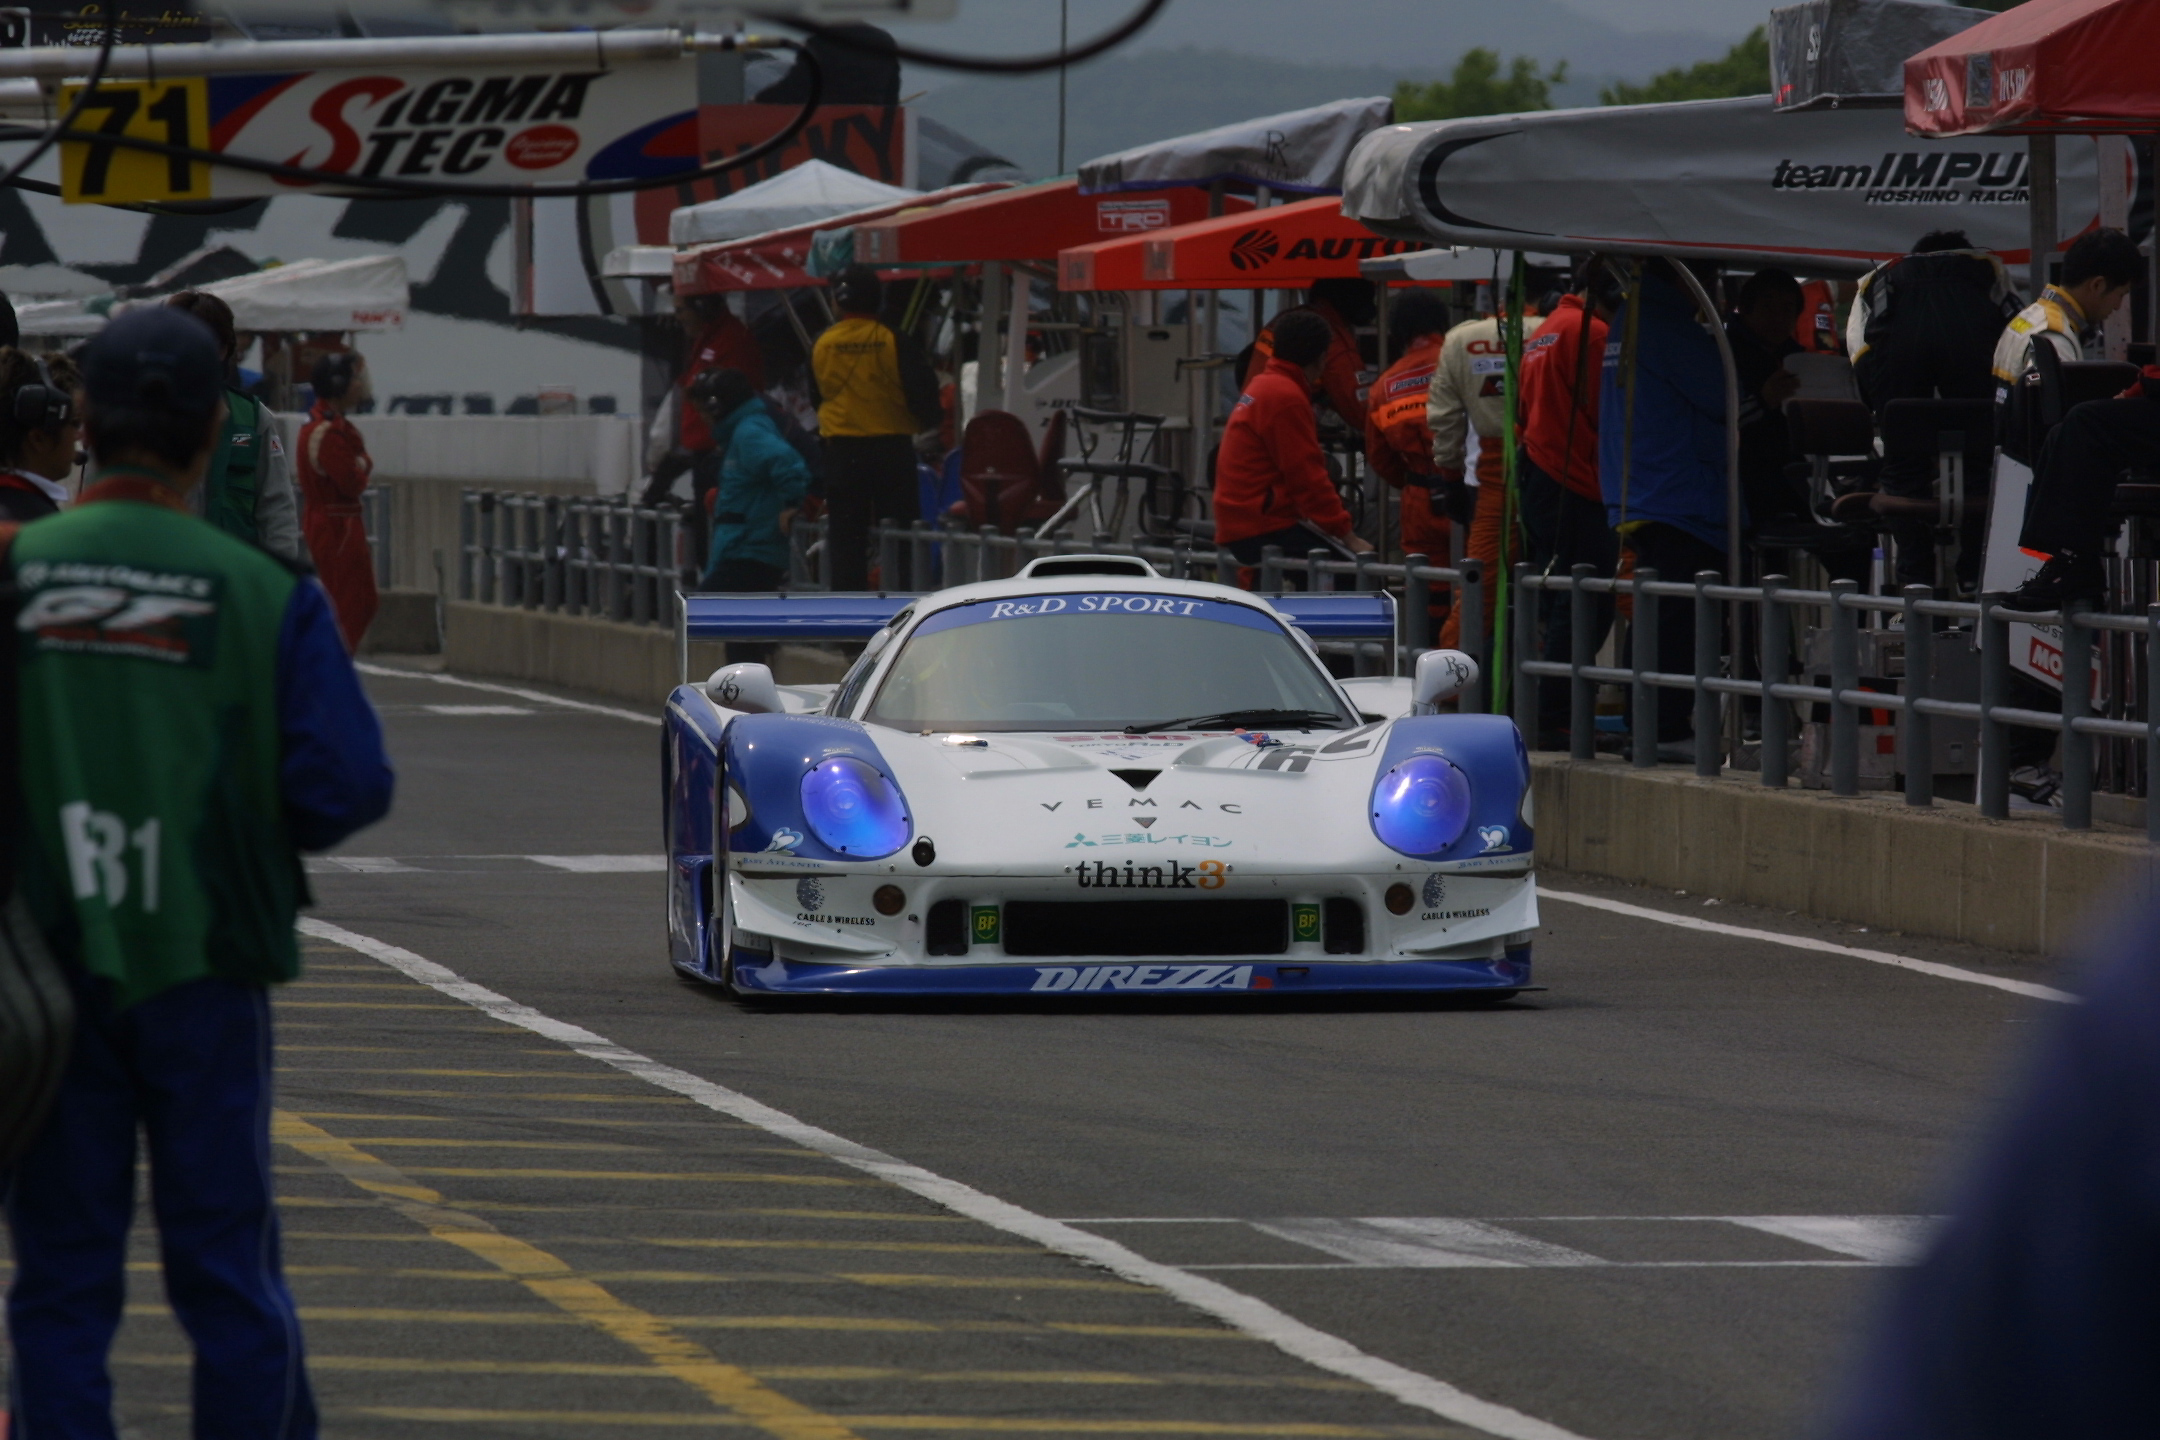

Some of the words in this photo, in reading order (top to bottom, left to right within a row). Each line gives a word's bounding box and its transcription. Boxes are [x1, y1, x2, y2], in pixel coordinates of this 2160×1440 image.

[272, 72, 611, 187] SIGMA
[70, 87, 191, 195] 71
[361, 128, 507, 178] TEC
[1864, 190, 1960, 202] HOSHINO
[1968, 190, 2029, 202] RACIN
[1283, 238, 1433, 259] AUTO
[989, 598, 1068, 618] R&D
[1078, 596, 1203, 615] SPORT
[1040, 797, 1242, 813] VEMAC
[1101, 833, 1232, 847] 三菱レイヨン
[1075, 860, 1225, 889] think3
[797, 913, 824, 923] CABLE
[835, 916, 875, 925] WIRELESS
[1298, 914, 1317, 928] BP
[1421, 911, 1444, 920] CABLE
[1453, 908, 1490, 918] WIRELESS
[978, 915, 997, 930] BP
[1030, 965, 1253, 991] DIREZZA
